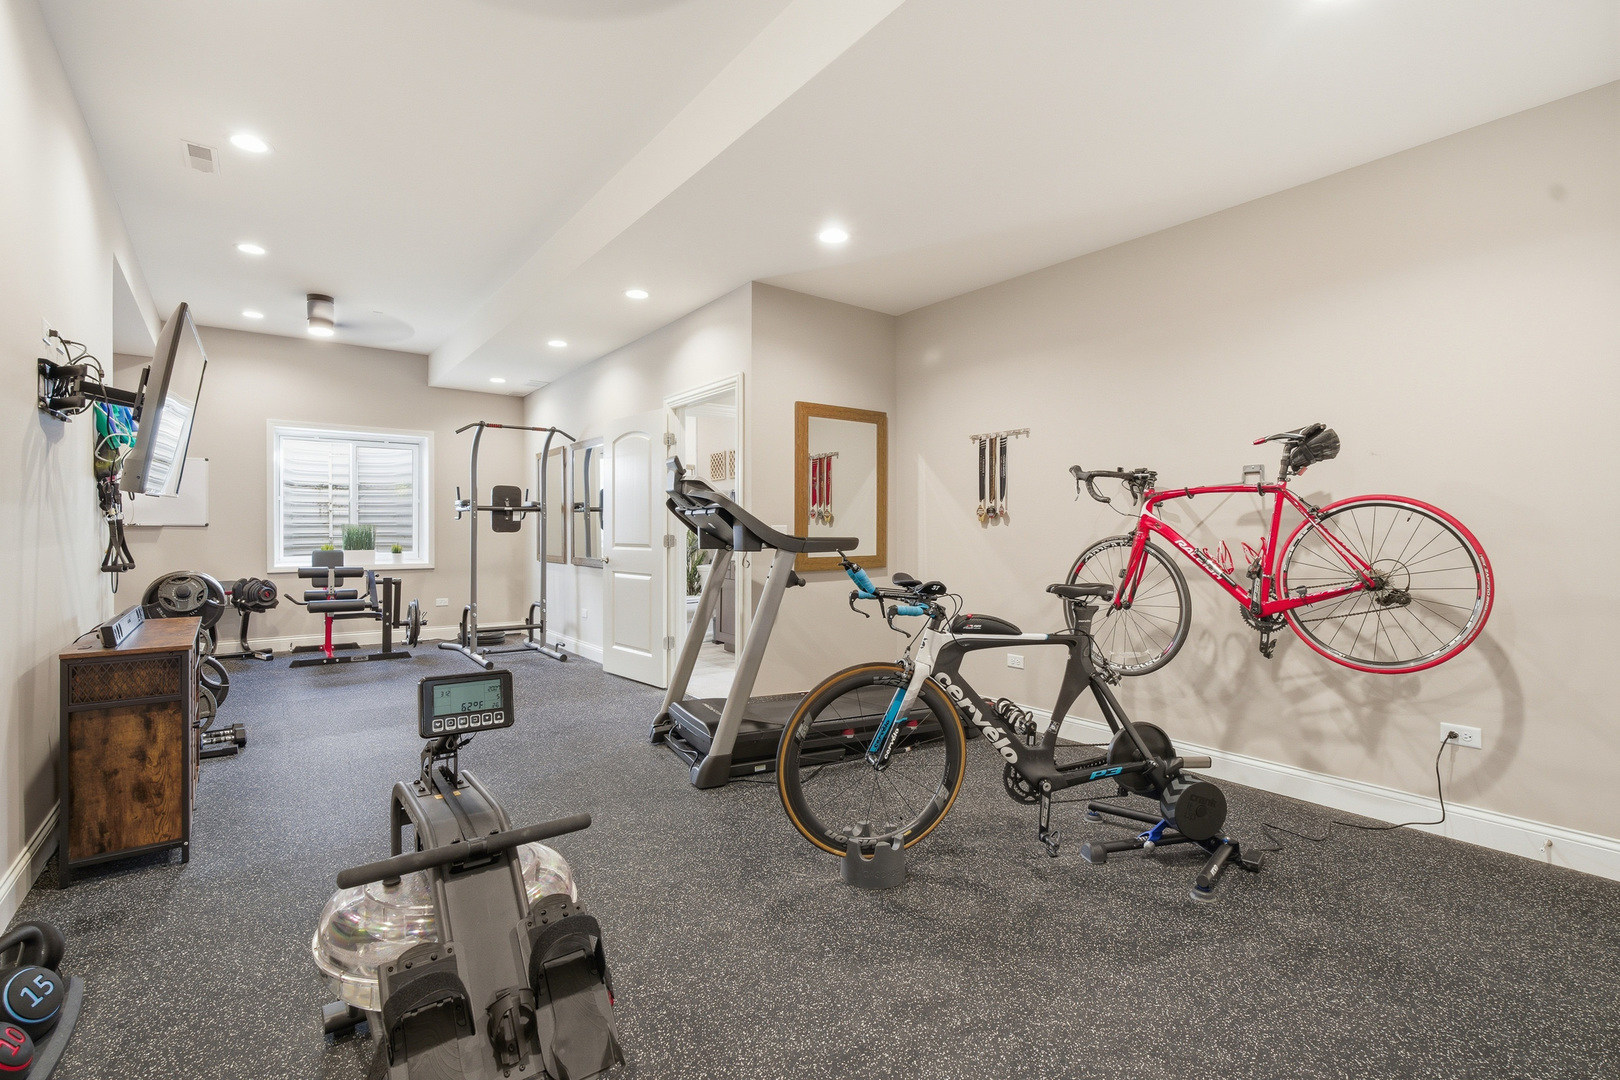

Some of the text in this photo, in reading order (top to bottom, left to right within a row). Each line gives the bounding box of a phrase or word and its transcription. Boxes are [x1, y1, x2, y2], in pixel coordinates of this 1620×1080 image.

[934, 672, 1018, 764] cervélo
[1089, 766, 1123, 780] P3
[20, 974, 55, 1008] 15
[0, 1026, 26, 1057] 10
